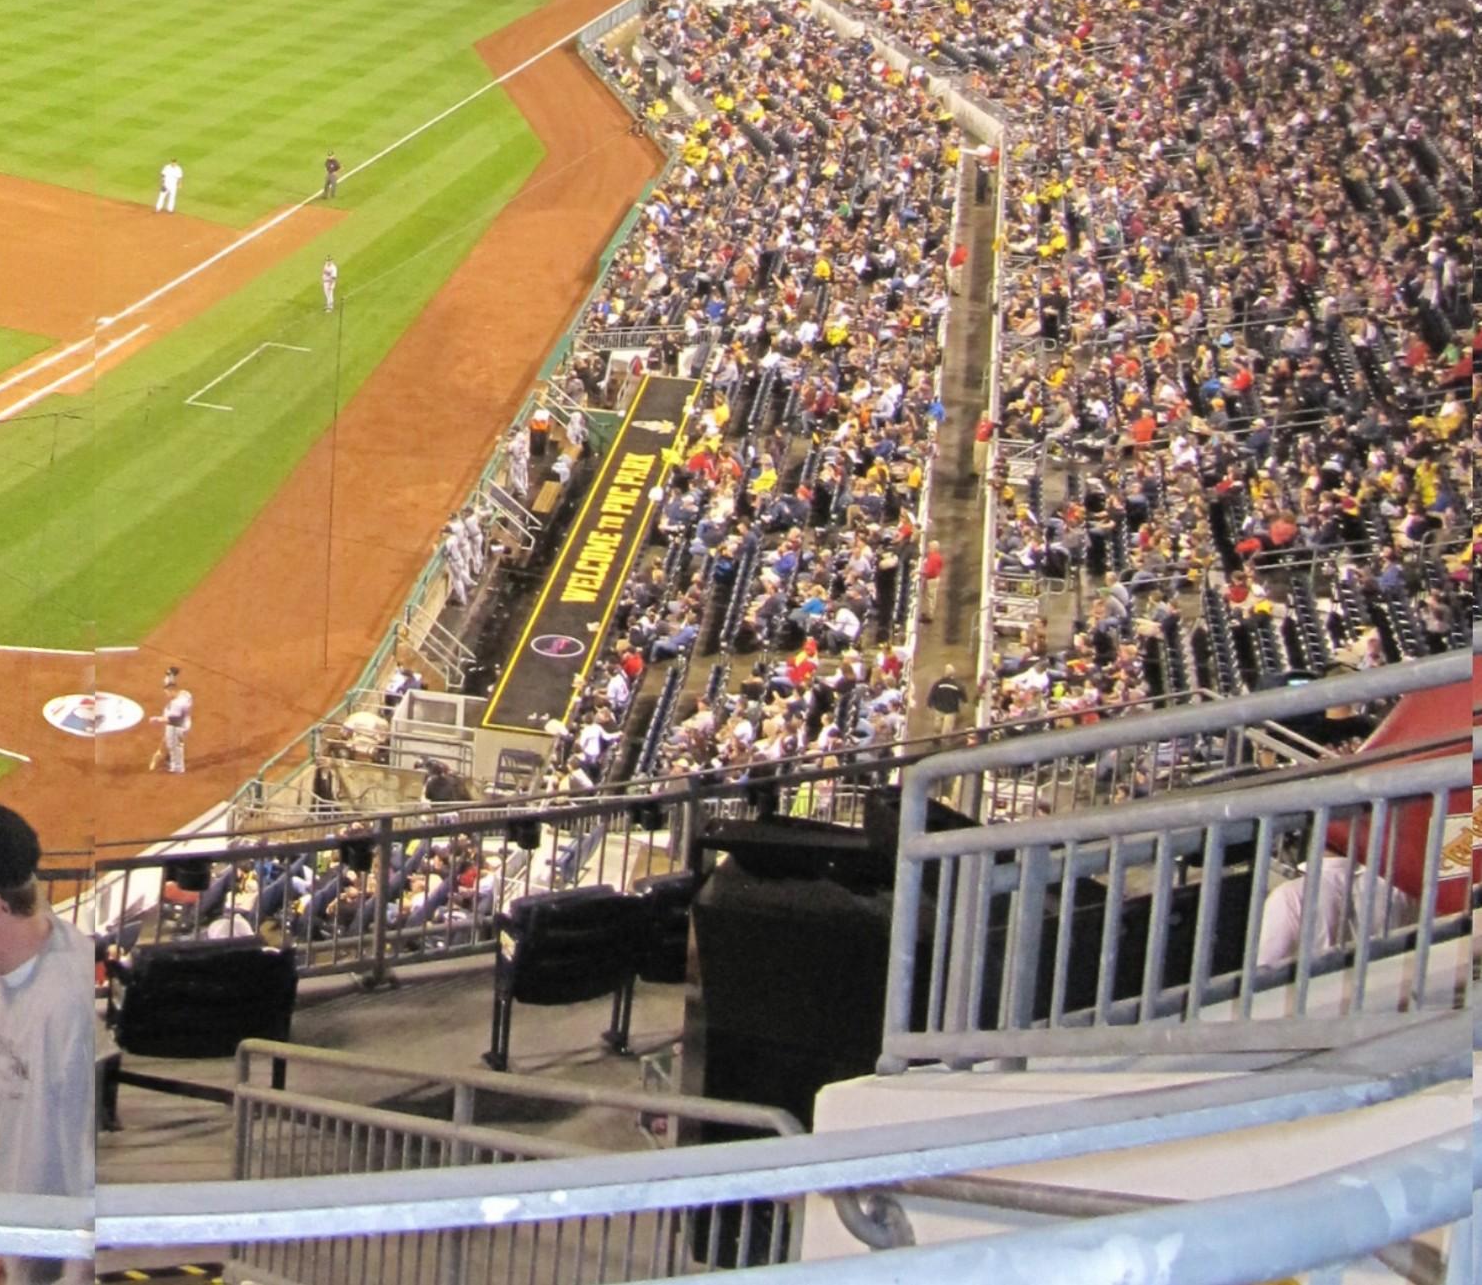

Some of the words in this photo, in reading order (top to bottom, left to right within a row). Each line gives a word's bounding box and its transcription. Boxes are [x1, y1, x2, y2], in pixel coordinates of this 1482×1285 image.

[613, 452, 656, 486] PARK
[601, 485, 641, 515] PNC
[598, 515, 625, 529] TO
[560, 530, 622, 602] WELCOME
